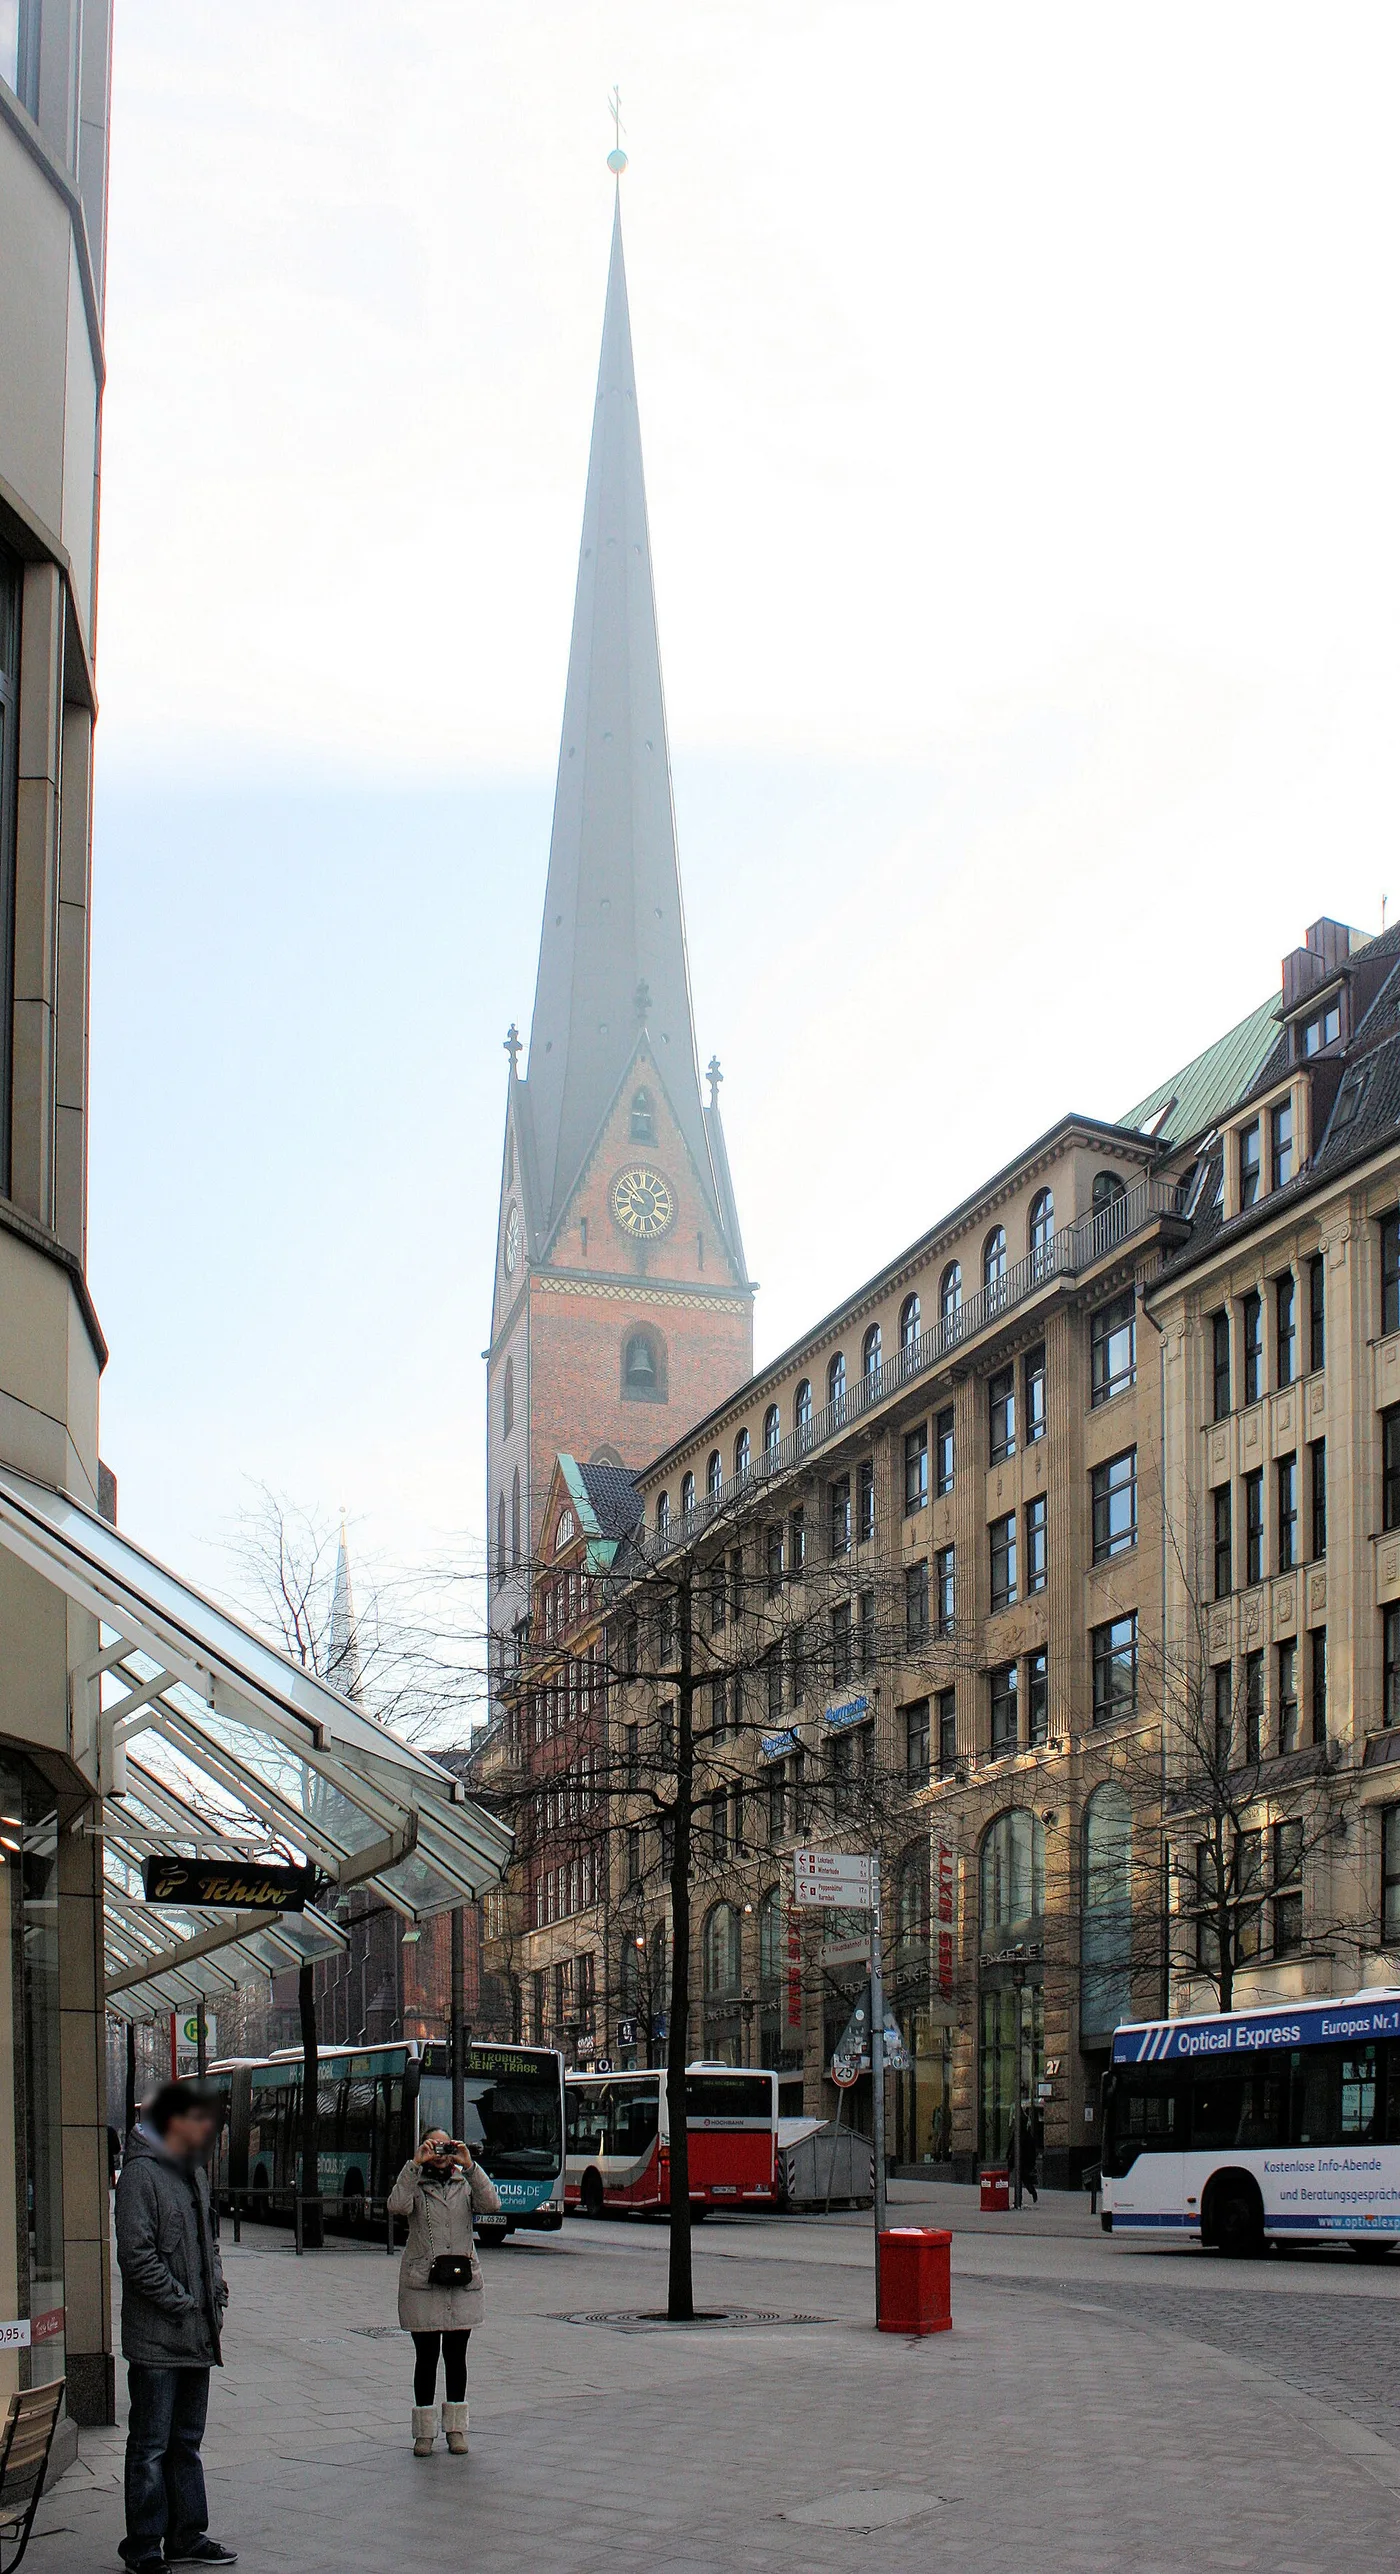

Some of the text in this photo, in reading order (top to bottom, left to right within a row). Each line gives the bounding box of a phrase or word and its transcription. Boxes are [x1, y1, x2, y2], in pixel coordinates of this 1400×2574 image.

[199, 1877, 297, 1904] Tchibo
[1178, 2029, 1232, 2056] Optical
[1235, 2025, 1301, 2050] Express
[1321, 2018, 1371, 2037] Europas
[425, 2050, 432, 2067] 3
[1046, 2059, 1061, 2075] 27
[1263, 2157, 1383, 2172] Kostenlose Info-Abende
[492, 2181, 540, 2196] haus.DE
[1280, 2186, 1400, 2203] und Beratungsgespräche
